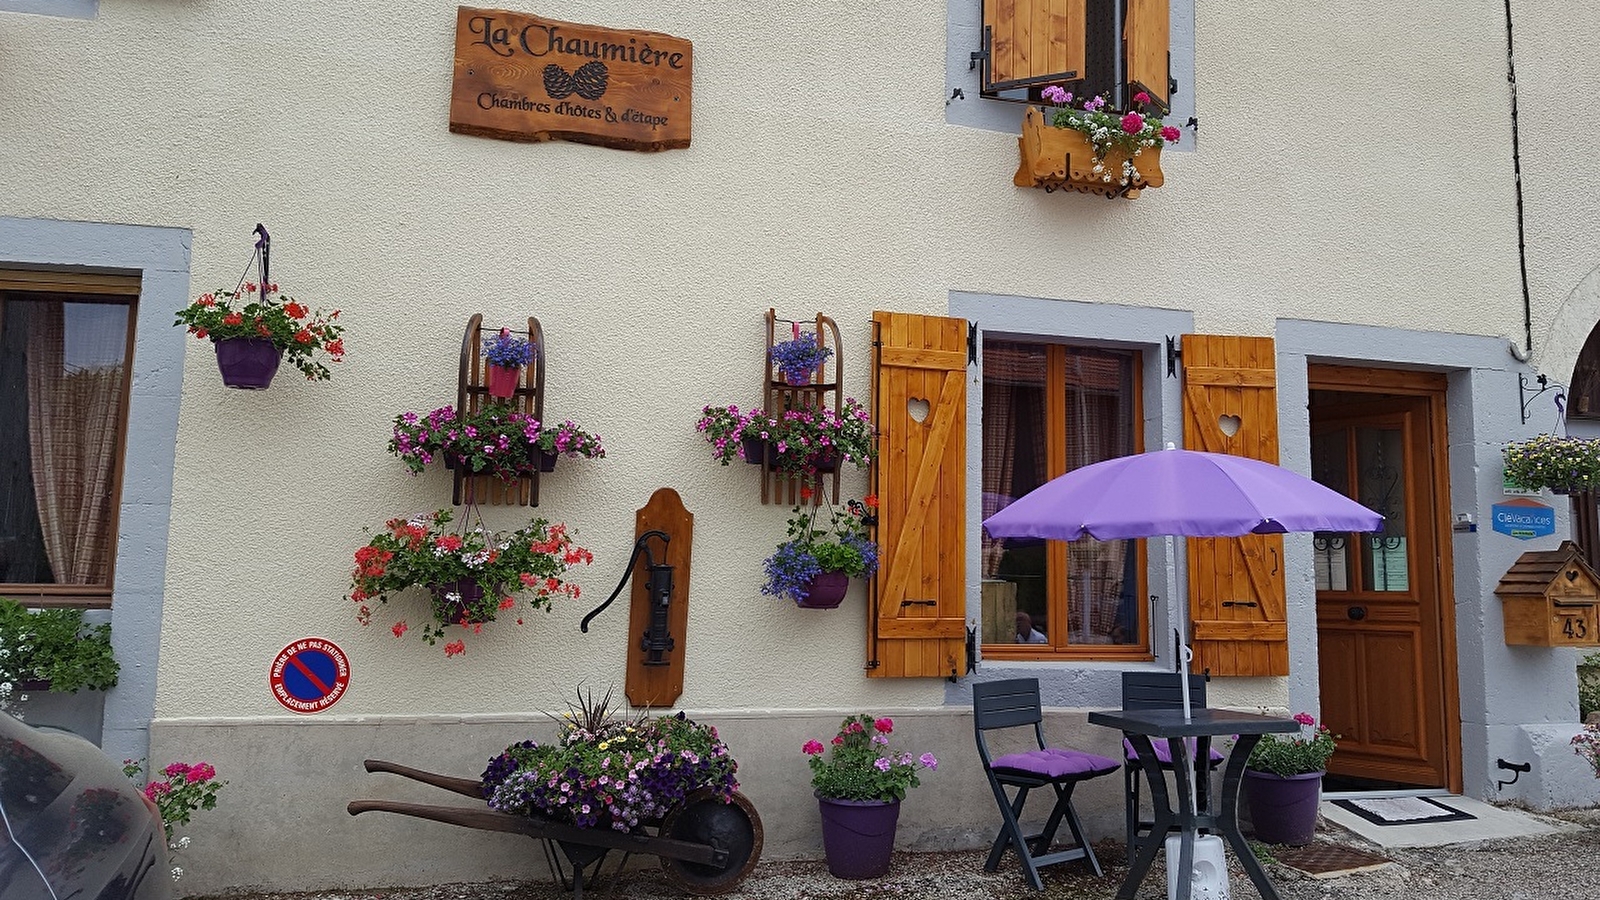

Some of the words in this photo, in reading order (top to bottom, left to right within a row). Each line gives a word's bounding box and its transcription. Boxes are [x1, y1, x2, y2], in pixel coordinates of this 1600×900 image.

[468, 17, 513, 57] La
[520, 24, 684, 69] Chaumière
[477, 93, 551, 114] Chambres
[555, 100, 601, 119] d'hôtes
[604, 107, 619, 123] &
[622, 109, 668, 131] d'étape
[1562, 617, 1587, 639] 43
[287, 646, 297, 656] DE
[297, 641, 307, 650] NE
[309, 641, 322, 649] PAS
[322, 644, 347, 677] STATIONNER
[274, 683, 318, 710] EMPLACEMENT
